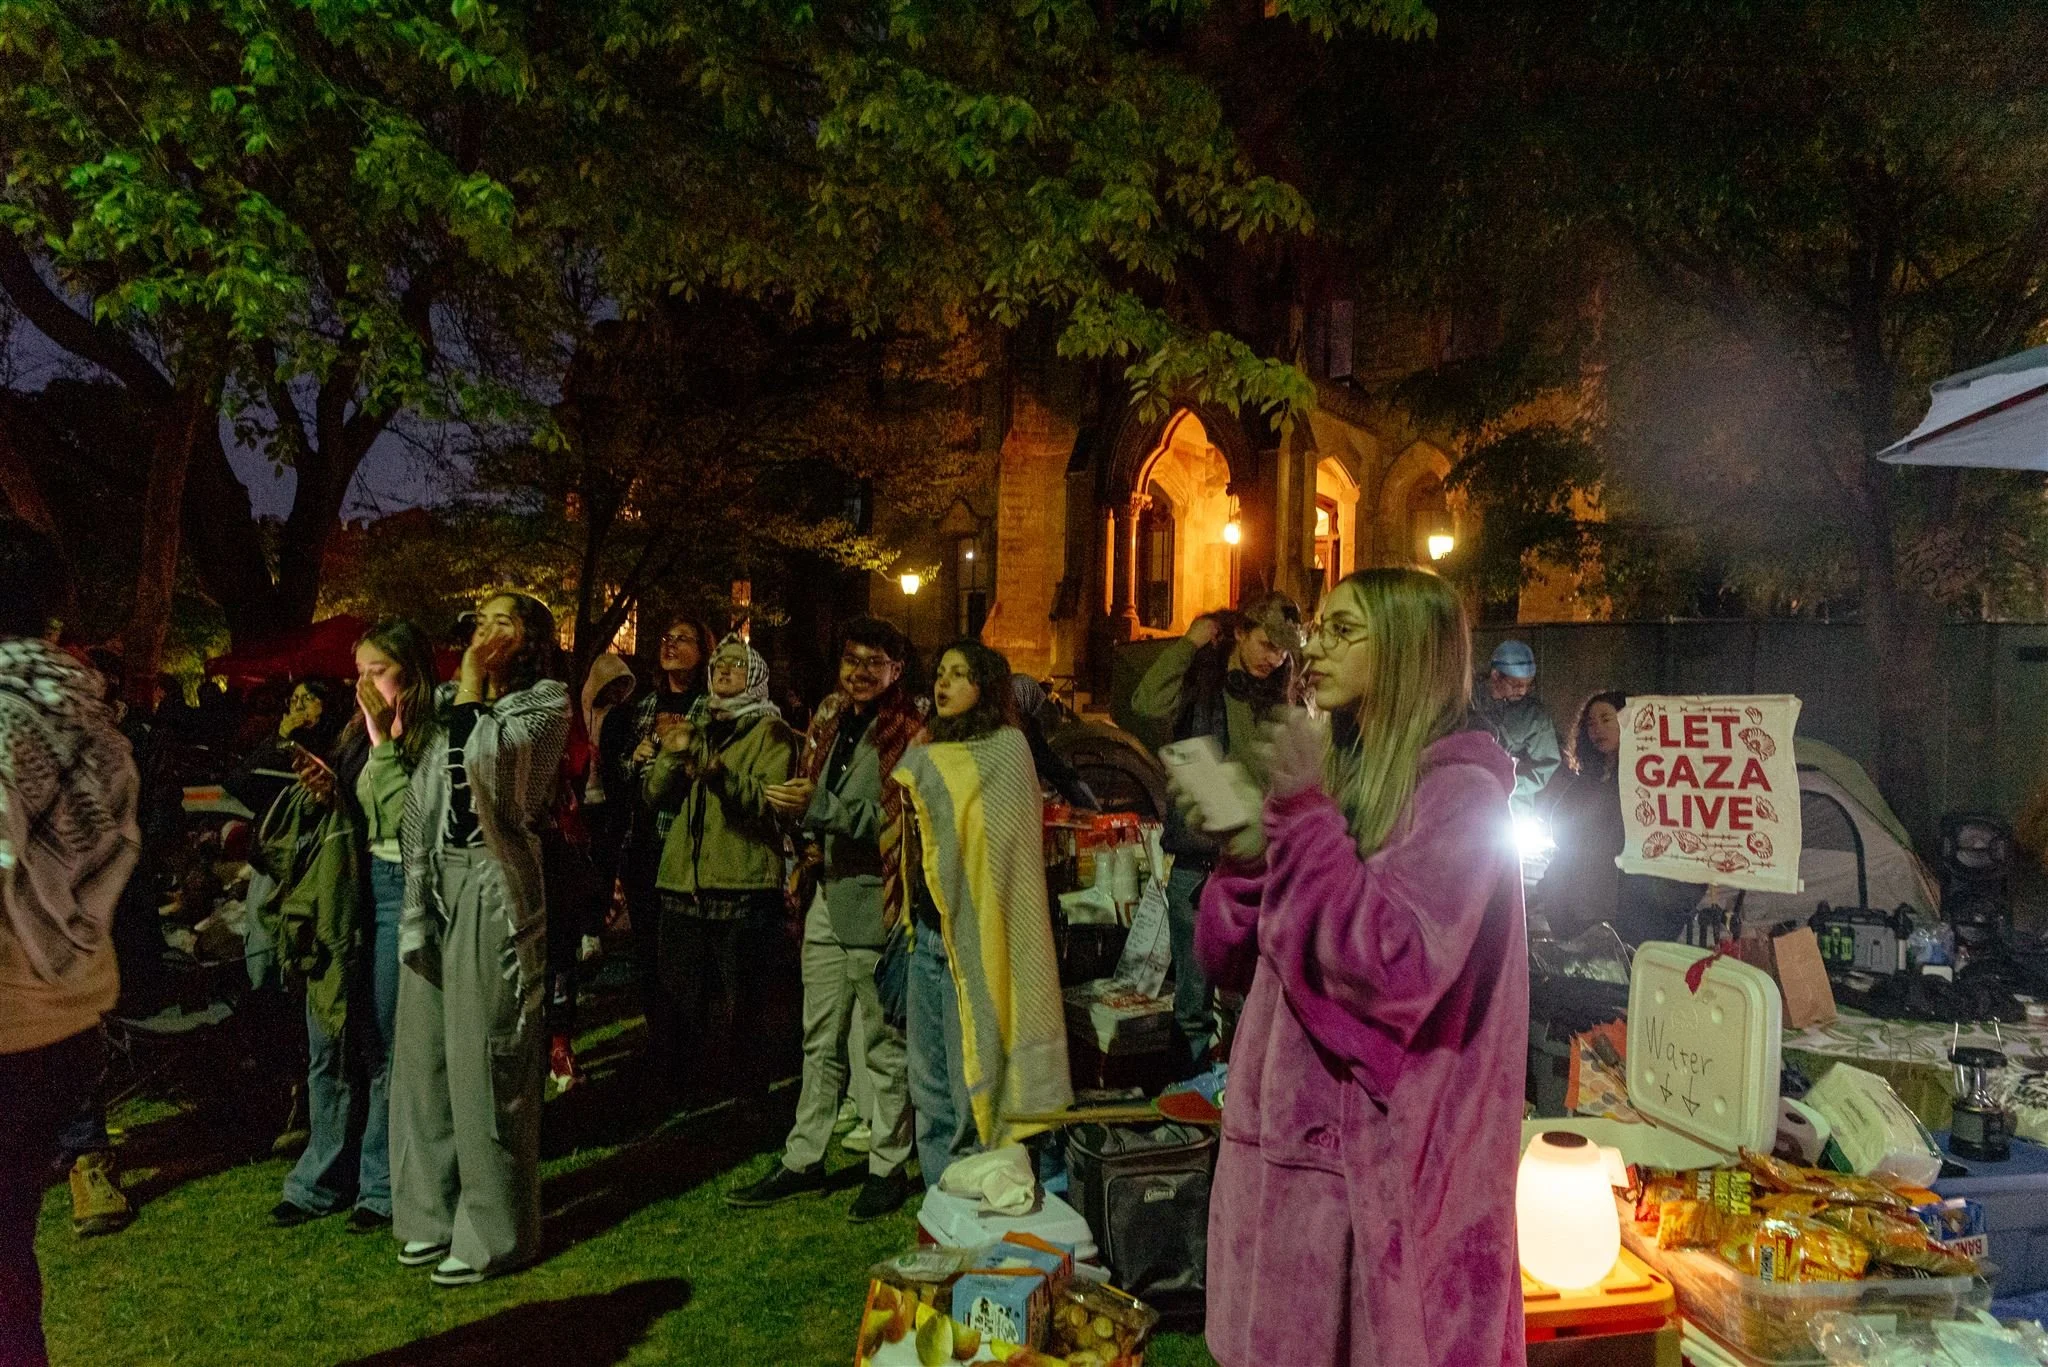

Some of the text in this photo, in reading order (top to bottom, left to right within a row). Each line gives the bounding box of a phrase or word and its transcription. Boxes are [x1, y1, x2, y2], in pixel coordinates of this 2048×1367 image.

[1659, 715, 1740, 748] LET
[1635, 755, 1772, 792] GAZA
[1657, 795, 1753, 830] LIVE
[1646, 1016, 1713, 1076] Water
